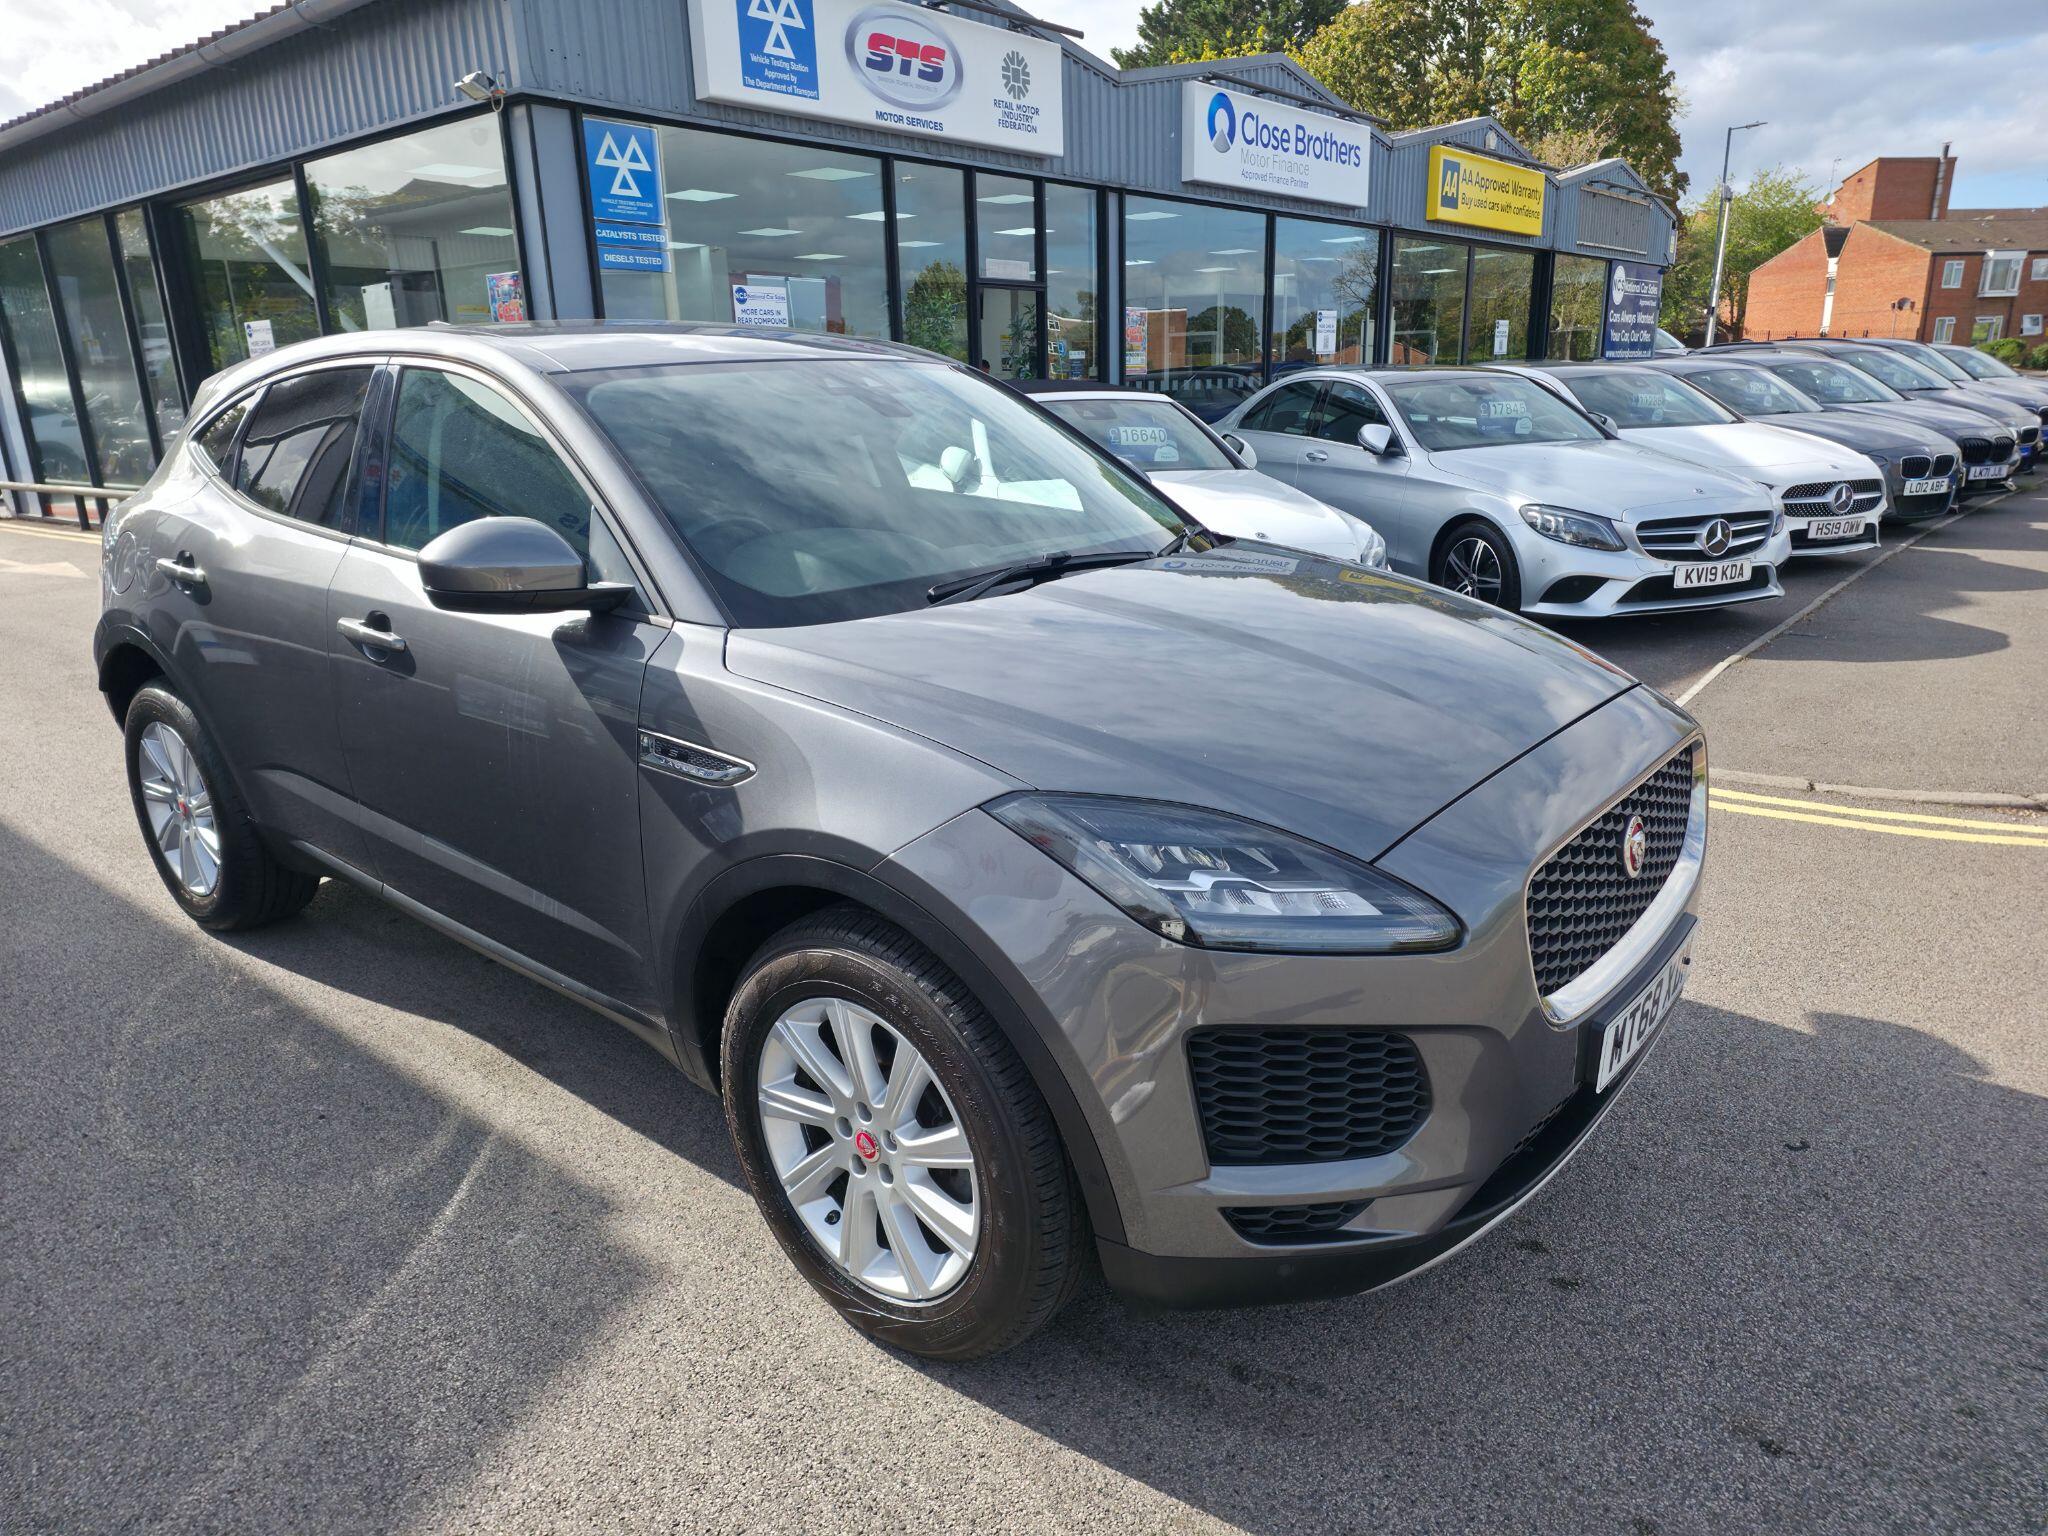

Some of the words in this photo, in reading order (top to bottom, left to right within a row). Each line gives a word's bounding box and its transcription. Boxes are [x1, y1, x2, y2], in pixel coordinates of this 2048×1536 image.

[750, 53, 770, 64] Vehicle
[771, 57, 790, 70] Testing
[791, 62, 809, 73] Station
[866, 32, 946, 83] STS
[764, 68, 790, 80] Approved
[791, 75, 797, 84] by
[744, 76, 755, 87] The
[756, 78, 786, 93] Department
[787, 85, 793, 93] of
[793, 86, 818, 98] Transport
[993, 99, 1014, 111] RETAIL
[1016, 104, 1040, 116] MOTOR
[1002, 110, 1033, 123] INDUSTRY
[875, 110, 905, 124] MOTOR
[906, 116, 944, 131] SERVICES
[998, 118, 1037, 133] FEDERATION
[1241, 112, 1291, 153] Close
[1295, 124, 1361, 168] Brothers
[1240, 148, 1270, 168] Motor
[1272, 154, 1310, 176] Finance
[1241, 168, 1268, 182] Approved
[1269, 172, 1289, 186] Finance
[1290, 175, 1309, 189] Partner
[1442, 170, 1458, 198] AA
[1461, 168, 1473, 185] AA
[1474, 171, 1510, 194] Approved
[1511, 180, 1542, 205] Warranty
[1461, 192, 1473, 209] Buy
[1474, 198, 1487, 208] used
[1488, 201, 1499, 211] cars
[1500, 201, 1512, 214] with
[1512, 204, 1540, 219] confidence
[595, 229, 637, 240] CATALYSTS
[637, 233, 665, 243] TESTED
[604, 253, 634, 264] DIESELS
[635, 256, 662, 265] TESTED
[1609, 310, 1620, 323] Cars
[1621, 311, 1636, 325] Always
[1610, 329, 1620, 342] Your
[1631, 330, 1639, 342] Our
[1815, 522, 1842, 536] HS19
[1843, 520, 1861, 534] OWW
[1684, 566, 1718, 584] KV19
[1721, 563, 1744, 581] KDA
[1609, 978, 1663, 1073] MT68
